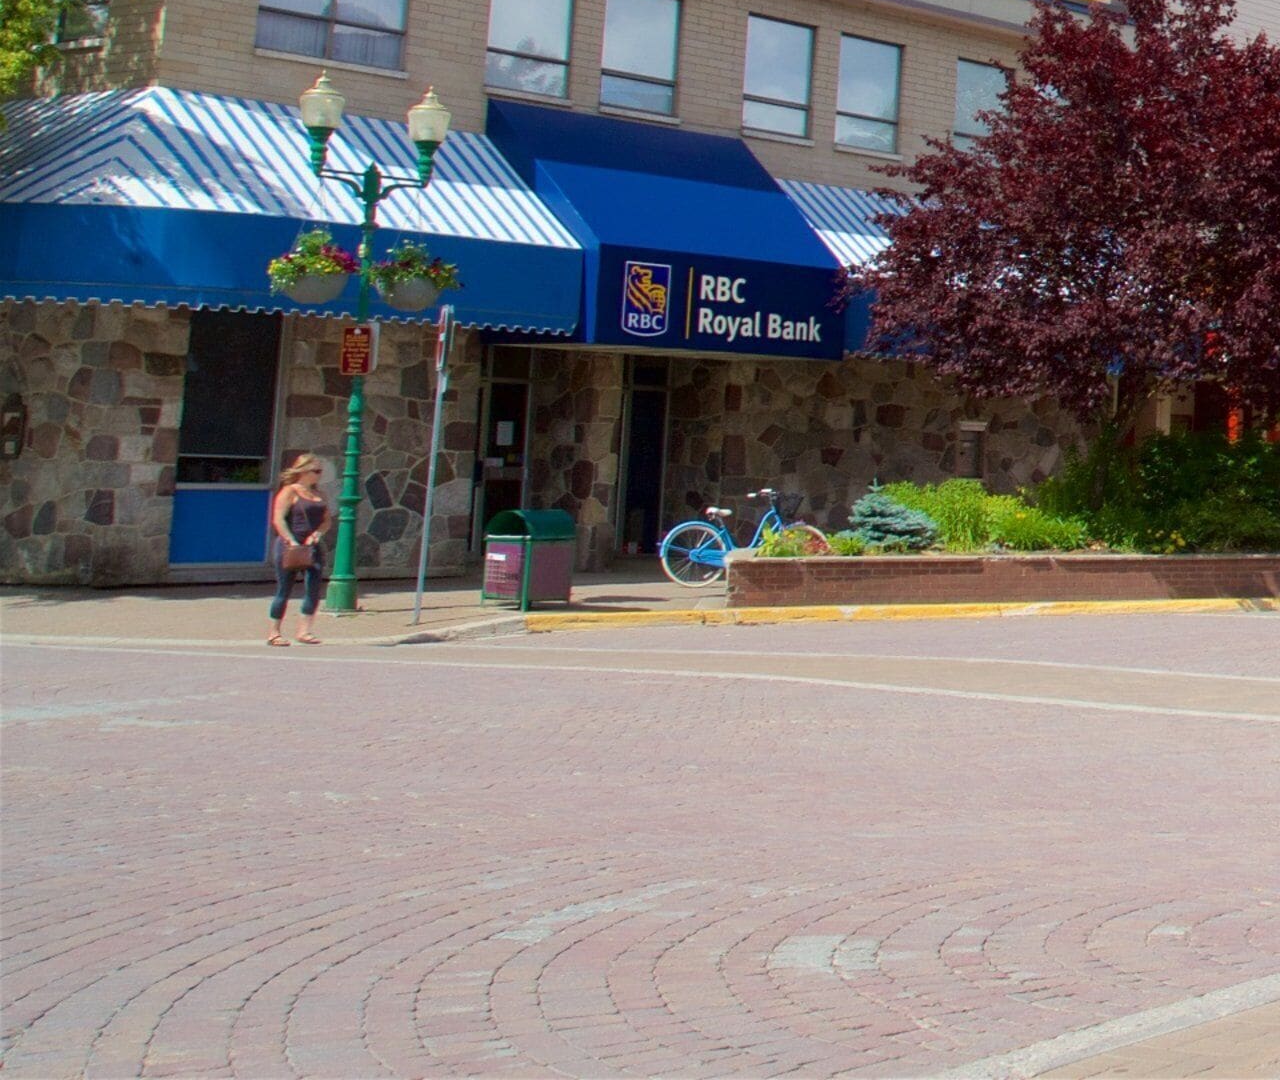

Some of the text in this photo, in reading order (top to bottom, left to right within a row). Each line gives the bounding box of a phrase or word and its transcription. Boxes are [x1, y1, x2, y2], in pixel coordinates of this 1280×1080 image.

[699, 274, 748, 304] RBC
[626, 312, 663, 330] RBC
[697, 308, 822, 343] Royal Bank
